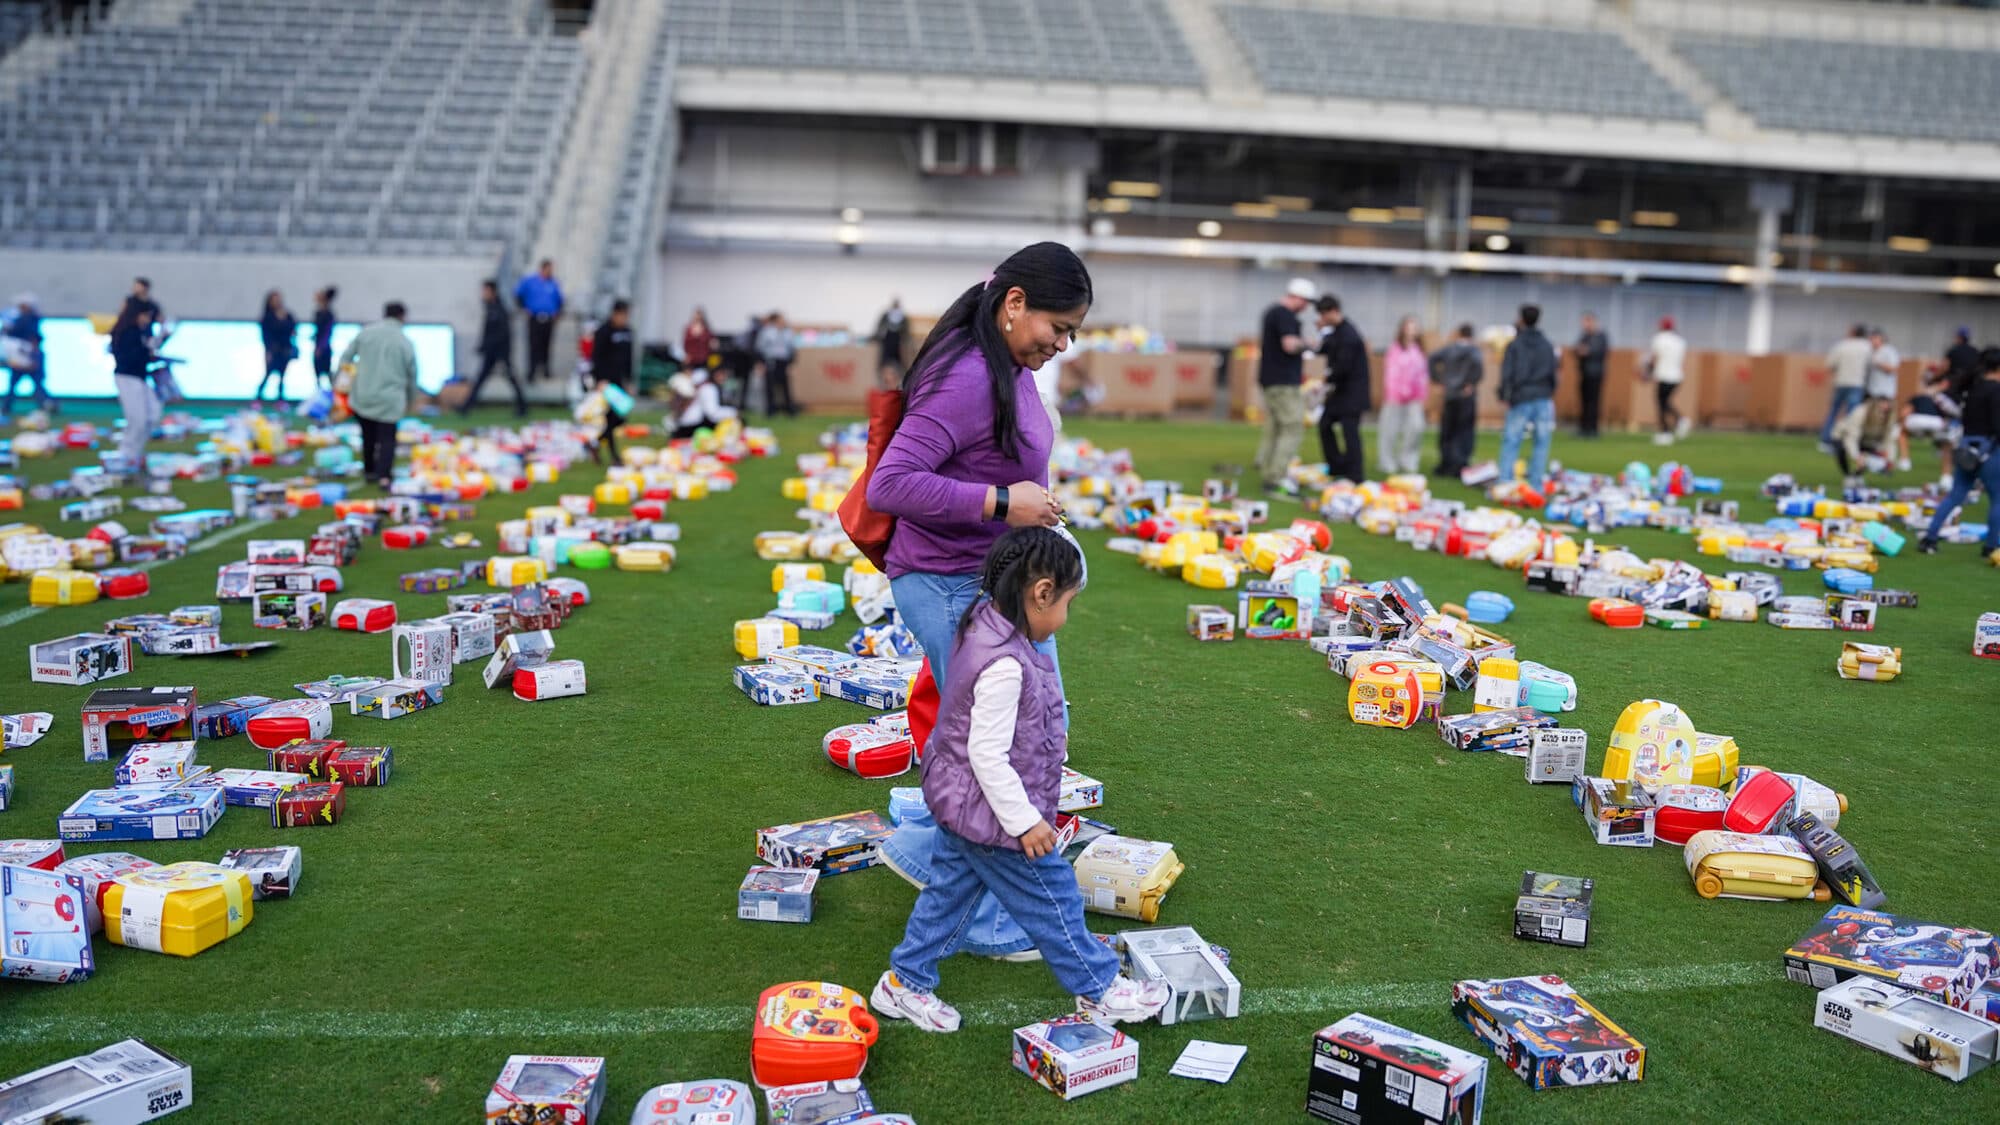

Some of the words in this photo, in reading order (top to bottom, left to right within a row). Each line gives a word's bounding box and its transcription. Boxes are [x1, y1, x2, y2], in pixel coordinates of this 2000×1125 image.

[130, 708, 171, 722] TUMBLER
[148, 713, 179, 725] VENOM
[1823, 1001, 1853, 1016] STAR
[1823, 1006, 1853, 1021] WARS
[1069, 1063, 1121, 1088] TRANSFORMERS
[147, 1090, 183, 1107] WARS
[147, 1097, 183, 1114] STAR
